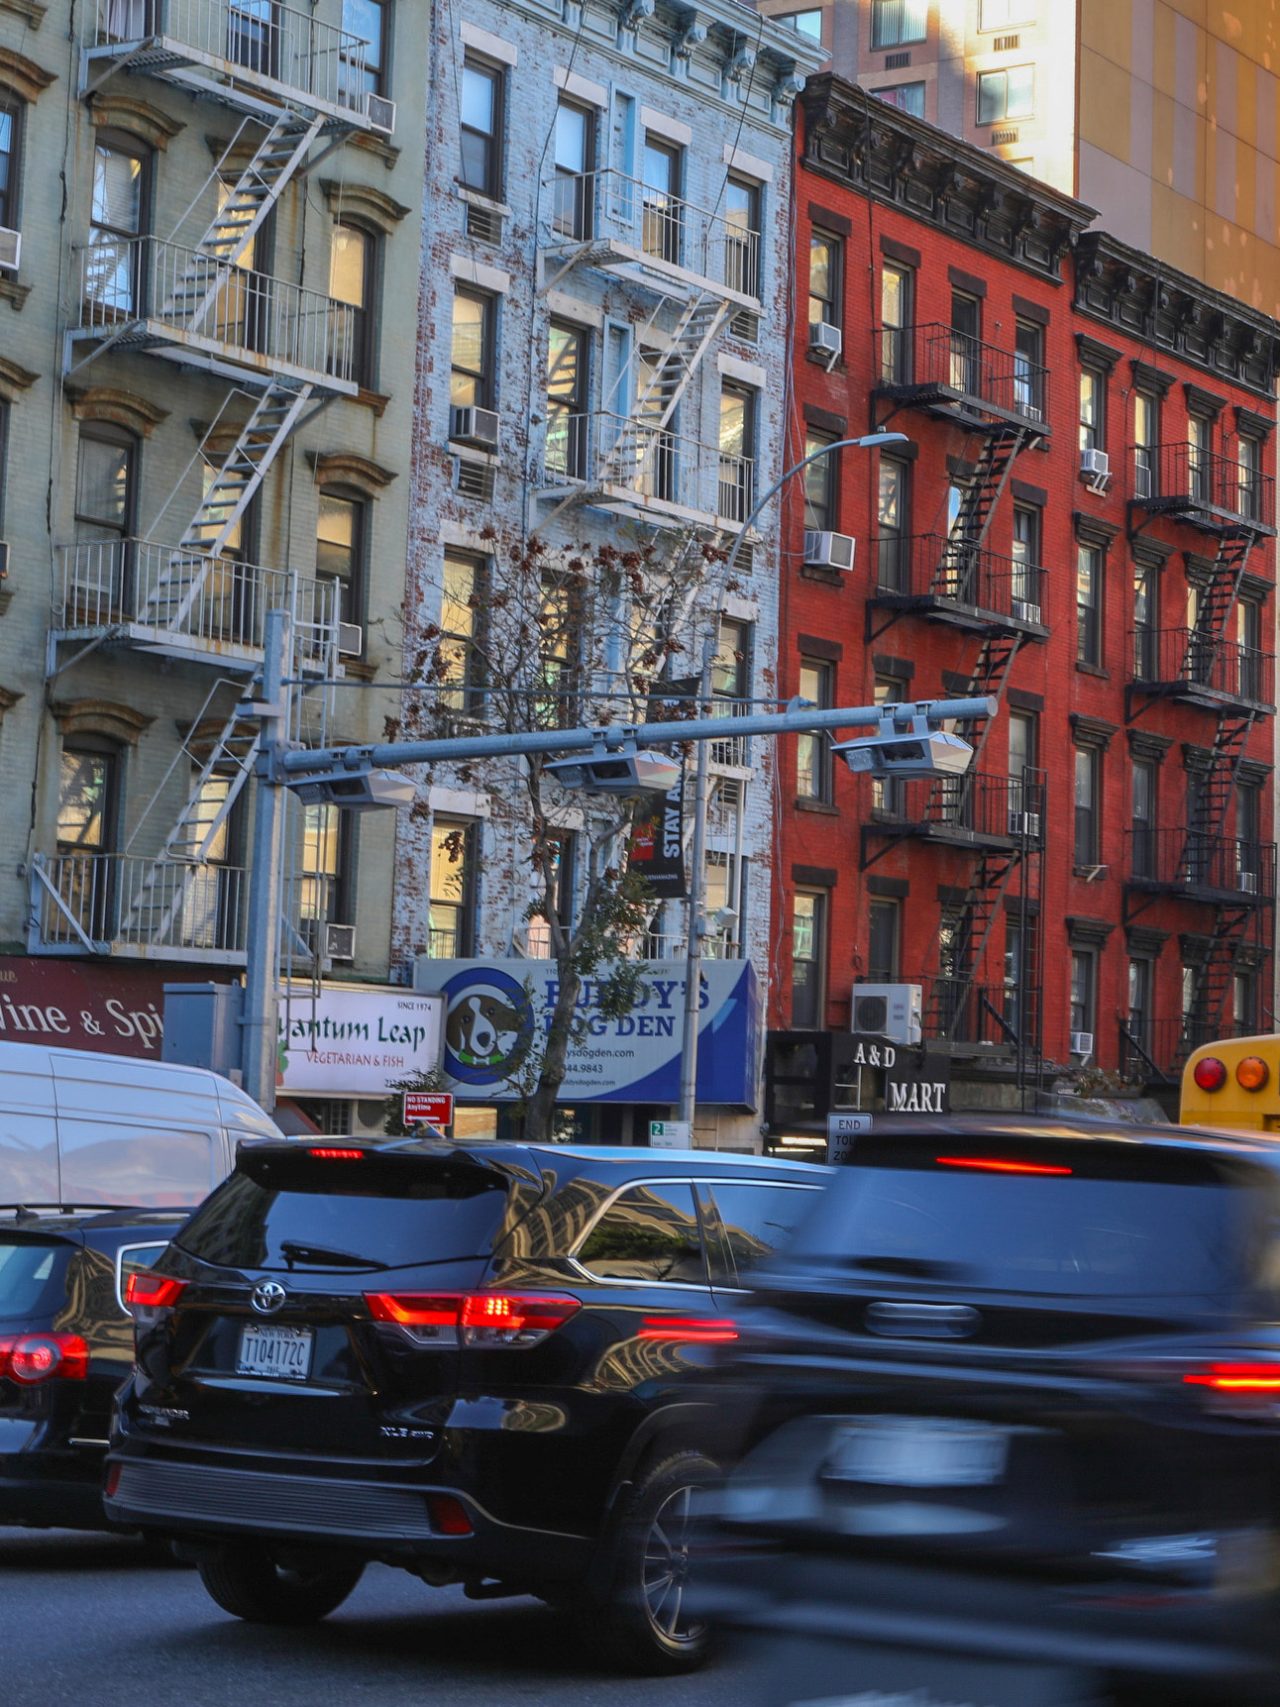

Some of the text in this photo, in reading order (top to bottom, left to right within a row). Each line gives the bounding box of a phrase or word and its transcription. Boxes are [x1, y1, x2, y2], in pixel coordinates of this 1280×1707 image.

[663, 808, 681, 859] STAY
[544, 980, 710, 1010] BUDY'S
[397, 1001, 432, 1012] SINCE 1974
[81, 1010, 105, 1036] &
[106, 999, 164, 1050] Spi
[277, 1015, 426, 1052] uantum Leap
[615, 1015, 676, 1037] DEN
[306, 1050, 404, 1068] VEGETARIAN & FISH
[854, 1042, 896, 1068] A & D
[564, 1064, 603, 1074] 44.9843
[417, 1096, 446, 1104] STANDING
[889, 1082, 946, 1113] MART
[653, 1123, 662, 1136] 2
[839, 1119, 861, 1130] END
[834, 1151, 847, 1161] ZO
[246, 1337, 305, 1366] T104172C
